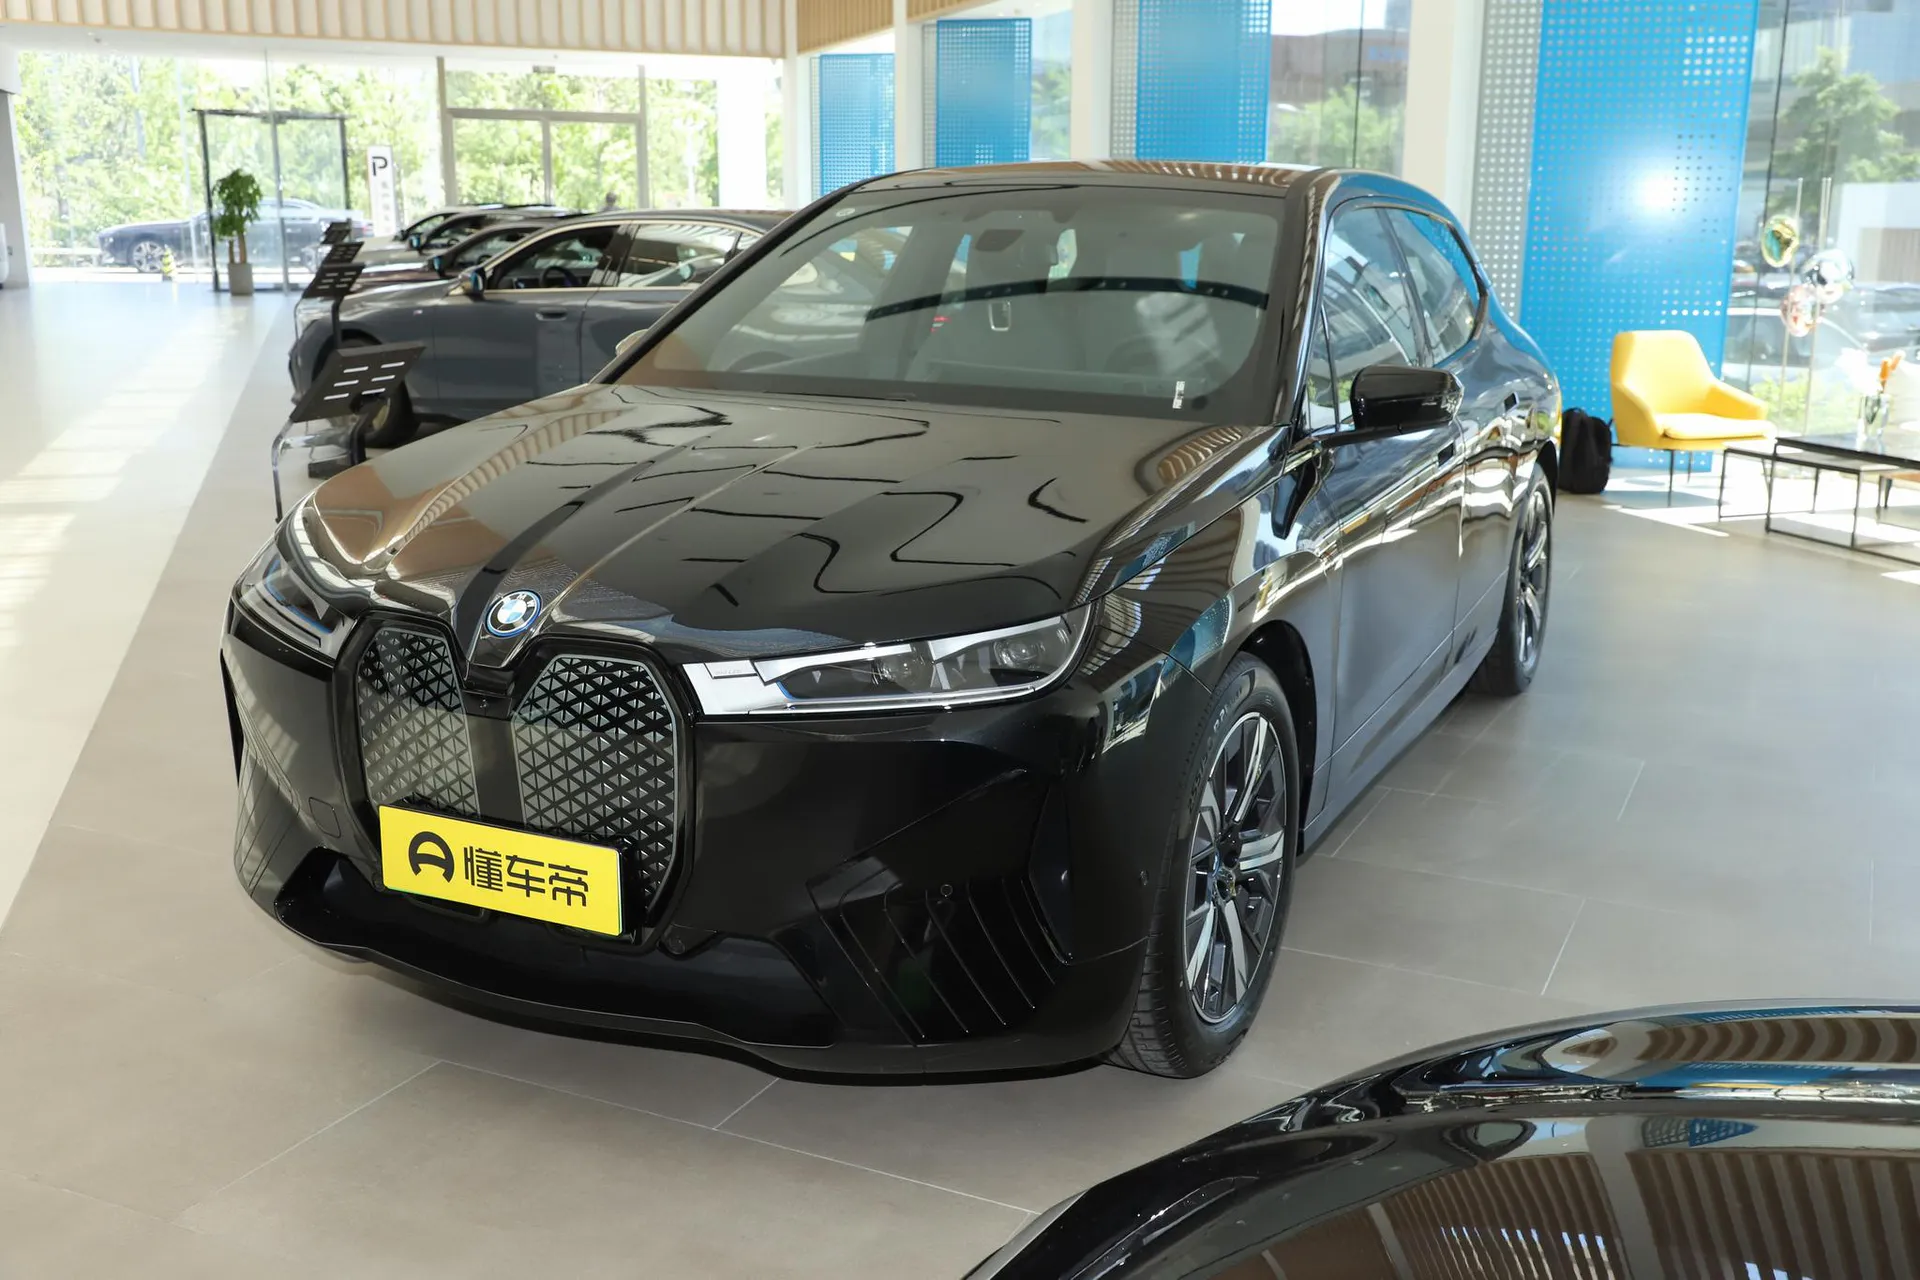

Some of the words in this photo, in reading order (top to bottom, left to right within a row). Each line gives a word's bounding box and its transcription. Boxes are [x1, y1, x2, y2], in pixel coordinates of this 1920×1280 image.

[372, 156, 388, 177] P
[464, 846, 588, 907] 懂车帝
